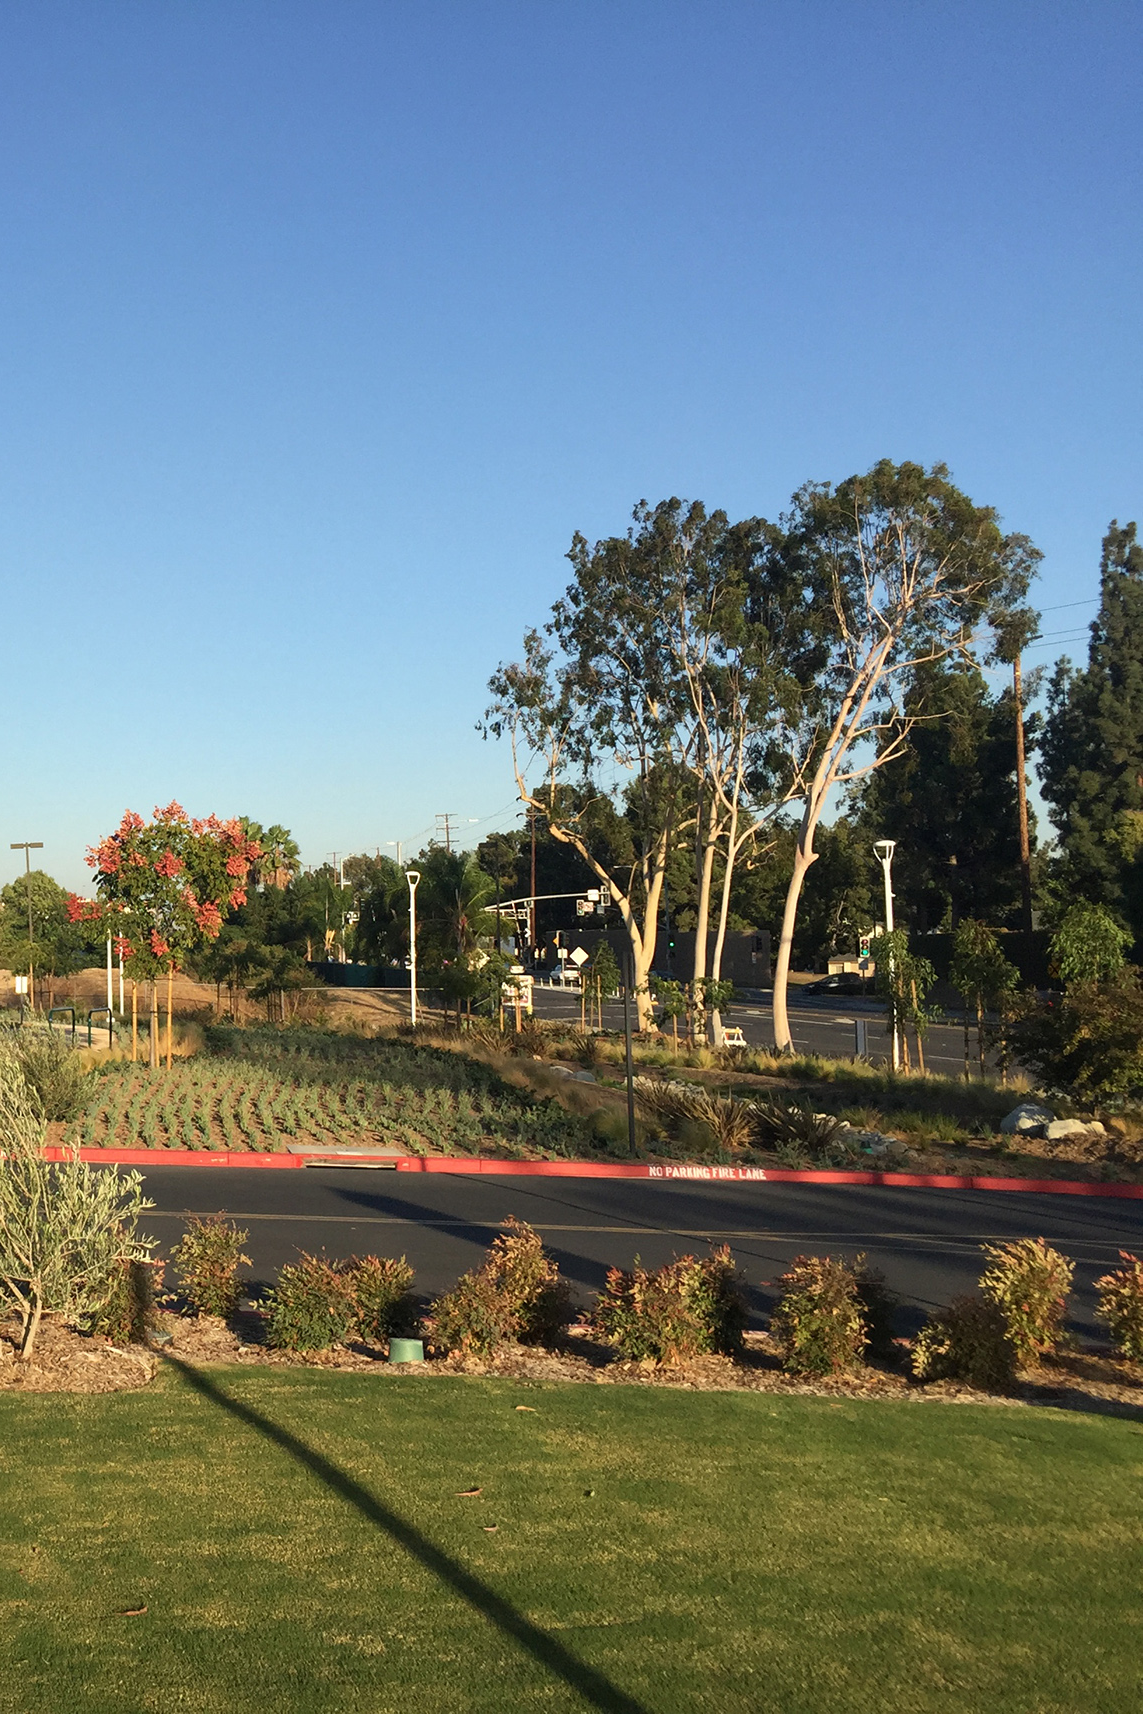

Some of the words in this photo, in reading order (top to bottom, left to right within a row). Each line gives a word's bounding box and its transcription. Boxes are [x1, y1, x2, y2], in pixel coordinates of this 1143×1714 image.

[649, 1166, 663, 1177] NO
[665, 1166, 711, 1179] PARKING
[712, 1167, 736, 1179] FIRE
[738, 1168, 767, 1180] LANE
